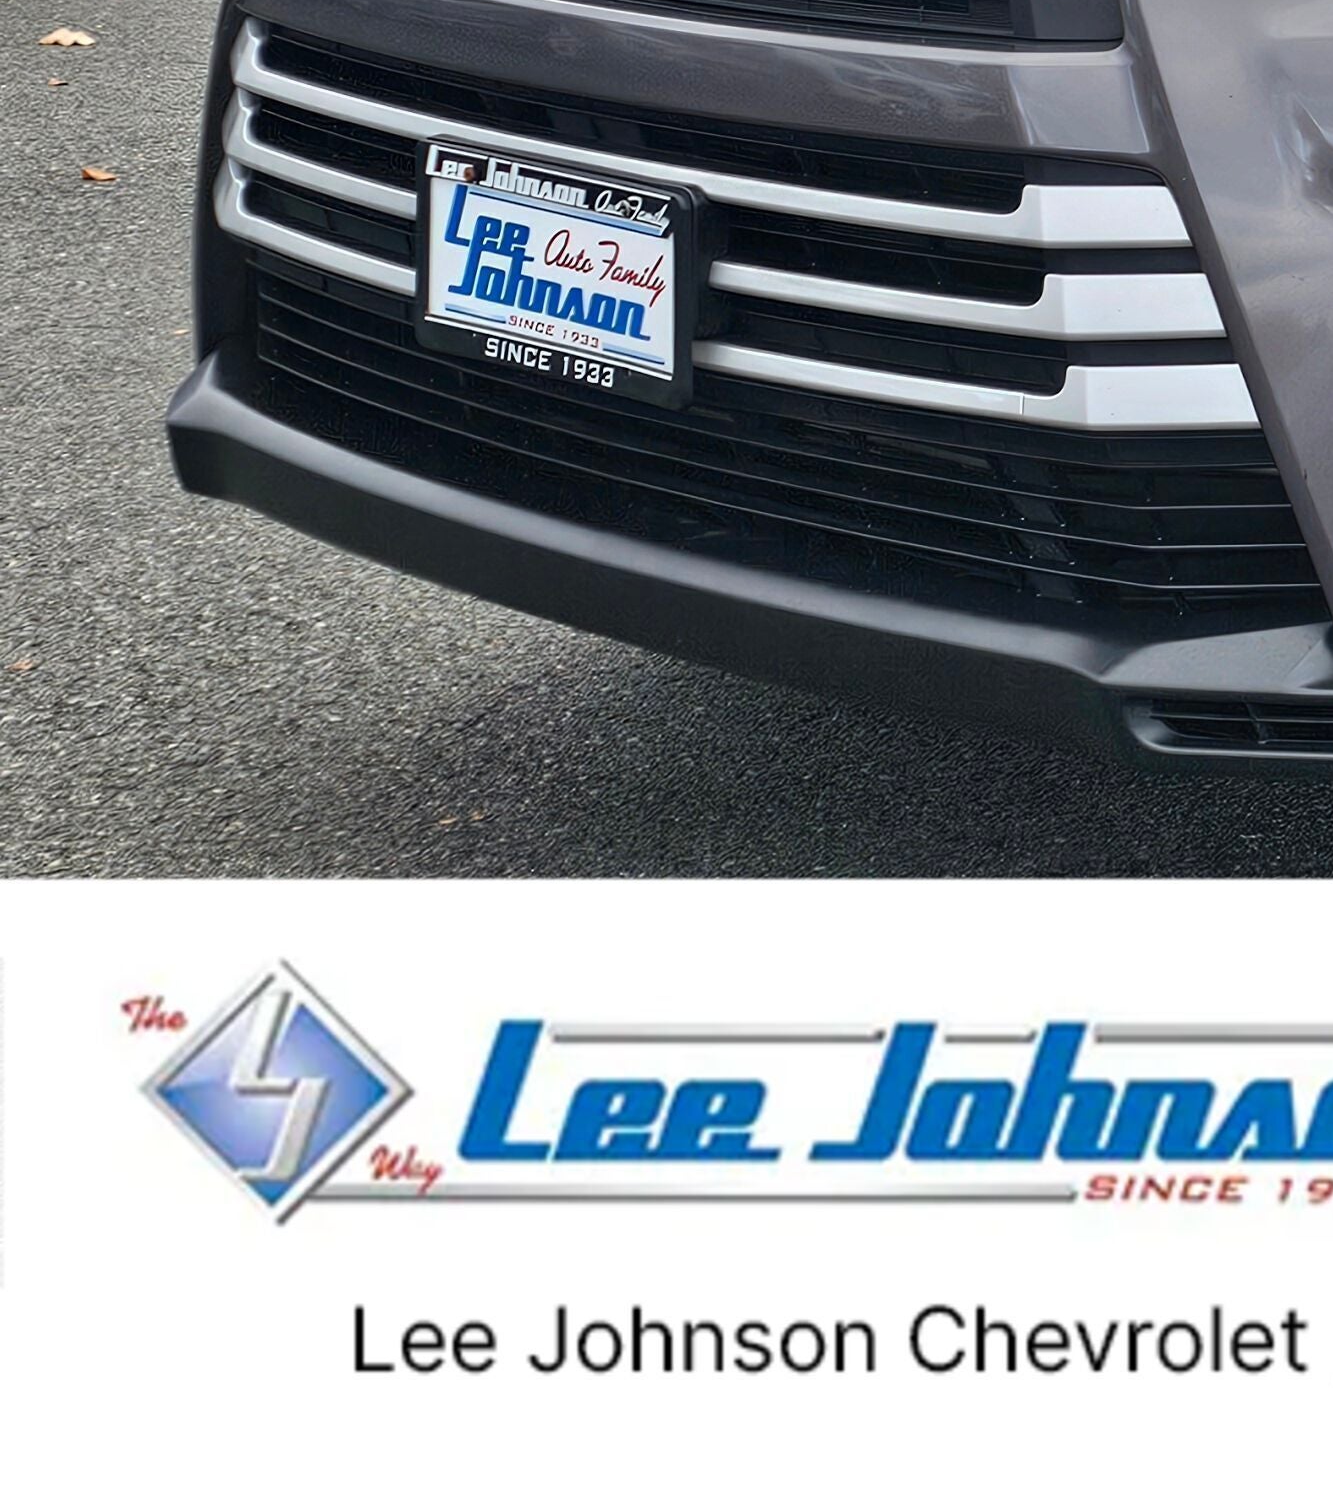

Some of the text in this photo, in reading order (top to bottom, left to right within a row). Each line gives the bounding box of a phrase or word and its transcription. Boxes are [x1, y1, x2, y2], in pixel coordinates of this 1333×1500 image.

[479, 157, 589, 209] Johnson
[444, 185, 534, 263] Lee
[447, 245, 652, 342] Johnson
[543, 230, 667, 308] Auto Family
[484, 337, 615, 388] SINCE 1933
[507, 314, 600, 349] SINCE 1933
